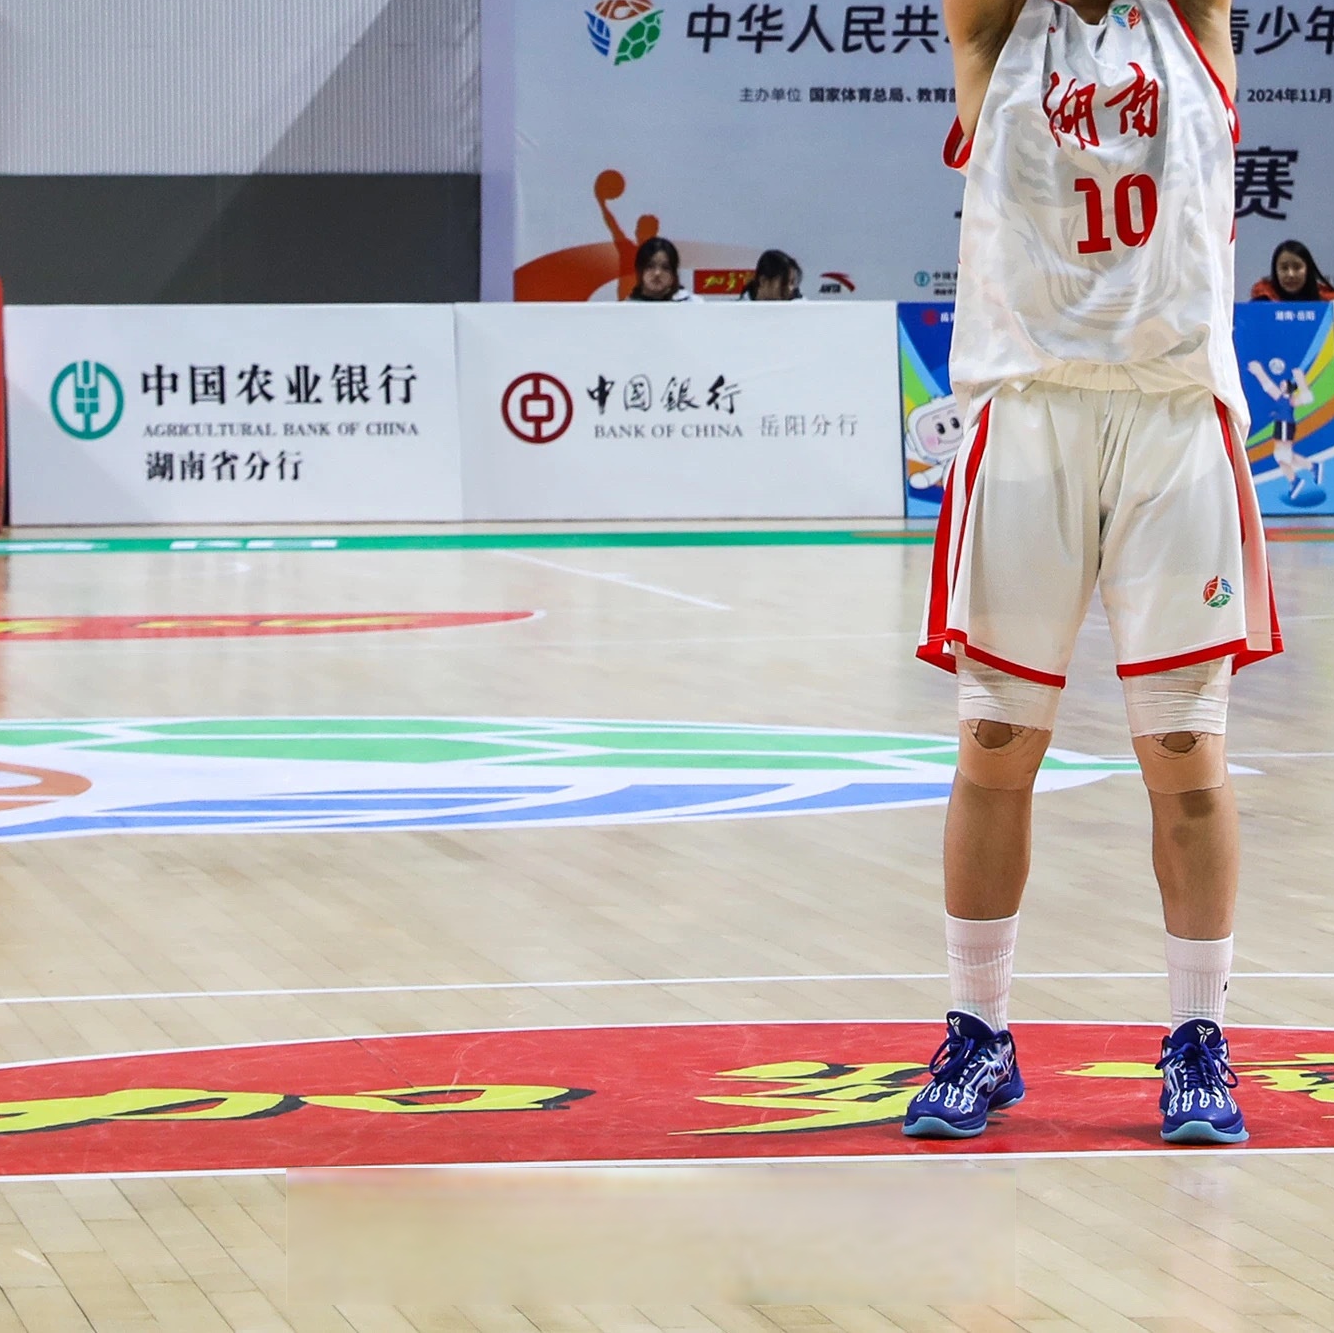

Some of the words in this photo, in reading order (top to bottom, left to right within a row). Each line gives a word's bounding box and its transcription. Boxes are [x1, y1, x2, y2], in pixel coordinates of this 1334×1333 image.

[686, 3, 950, 54] 中华人民共
[1247, 88, 1332, 103] 2024年11月
[1074, 173, 1158, 254] 10
[141, 363, 417, 406] 中国农业银行
[142, 422, 277, 437] AGRICULTURAL
[283, 422, 330, 436] BANK
[337, 422, 360, 436] OF
[366, 422, 419, 436] CHINA
[594, 424, 645, 438] BANK
[651, 424, 675, 438] OF
[681, 423, 744, 438] CHINA
[760, 415, 858, 437] 岳阳分行
[146, 450, 303, 482] 湖南省分行
